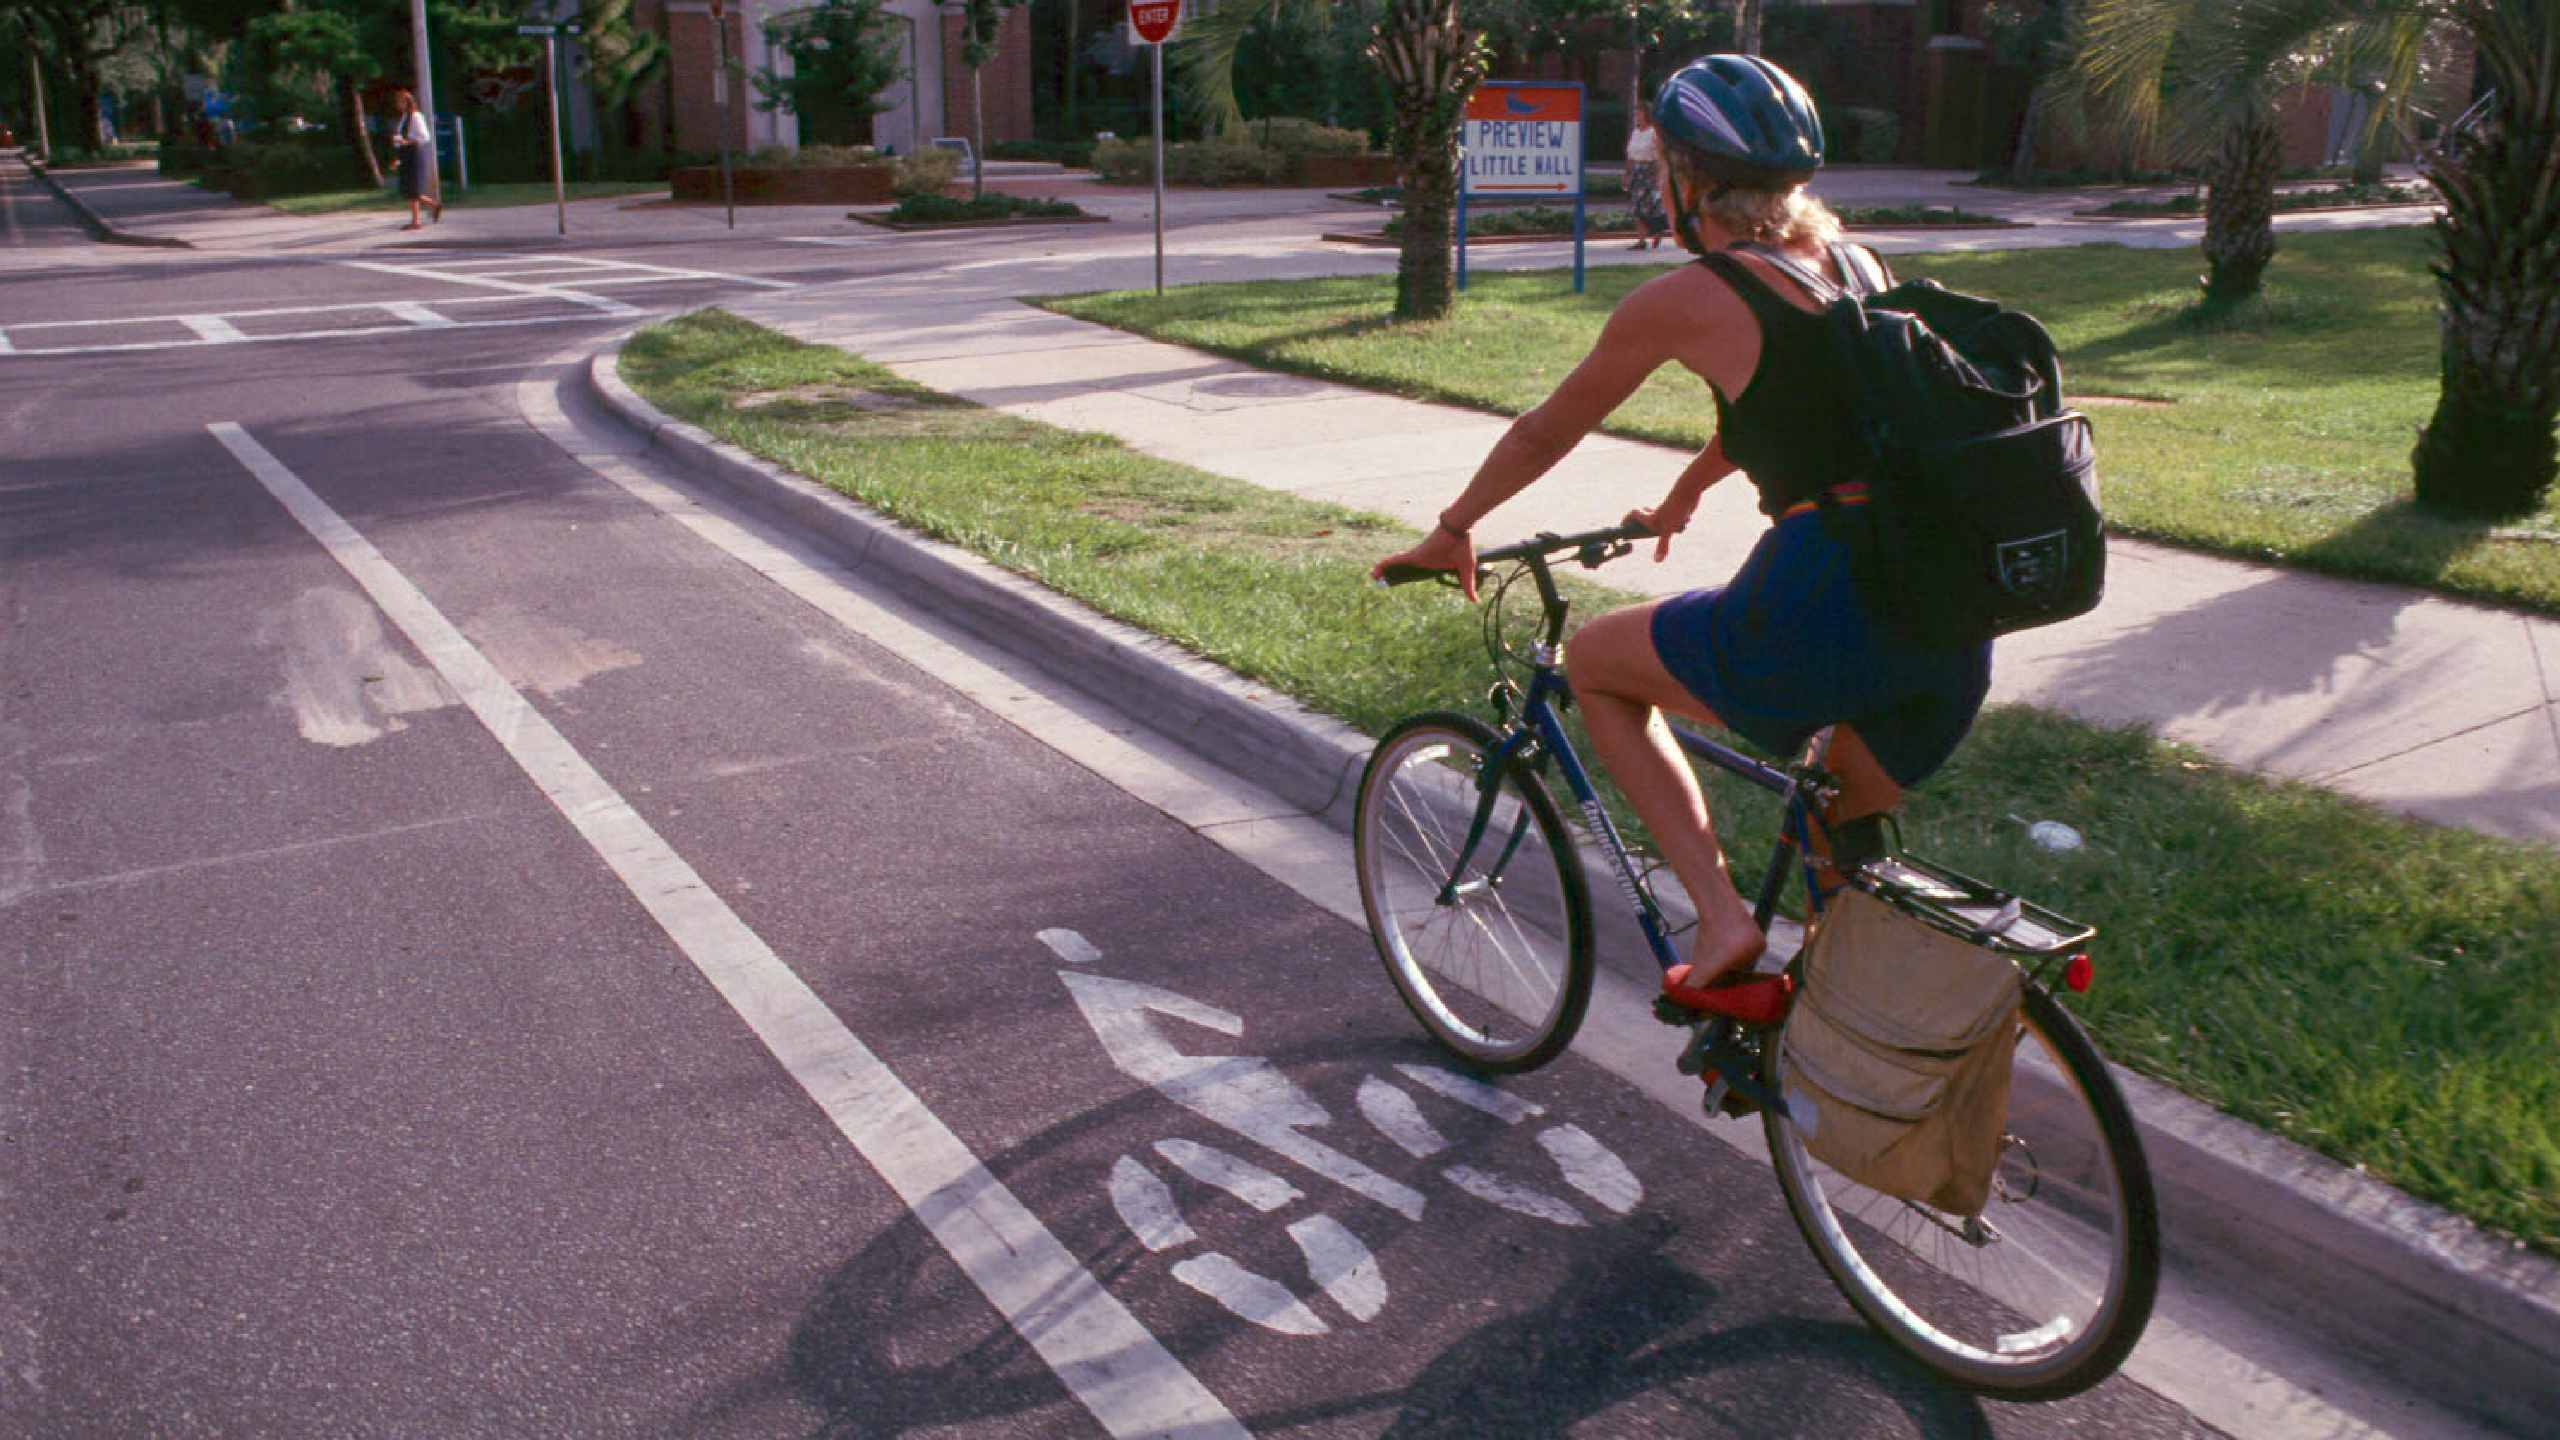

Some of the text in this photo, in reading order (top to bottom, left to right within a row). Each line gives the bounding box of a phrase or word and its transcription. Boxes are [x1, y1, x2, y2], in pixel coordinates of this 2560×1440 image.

[1138, 6, 1169, 25] ENTER
[1479, 121, 1566, 149] PREVIEW
[1469, 155, 1573, 176] LITTLE HALL
